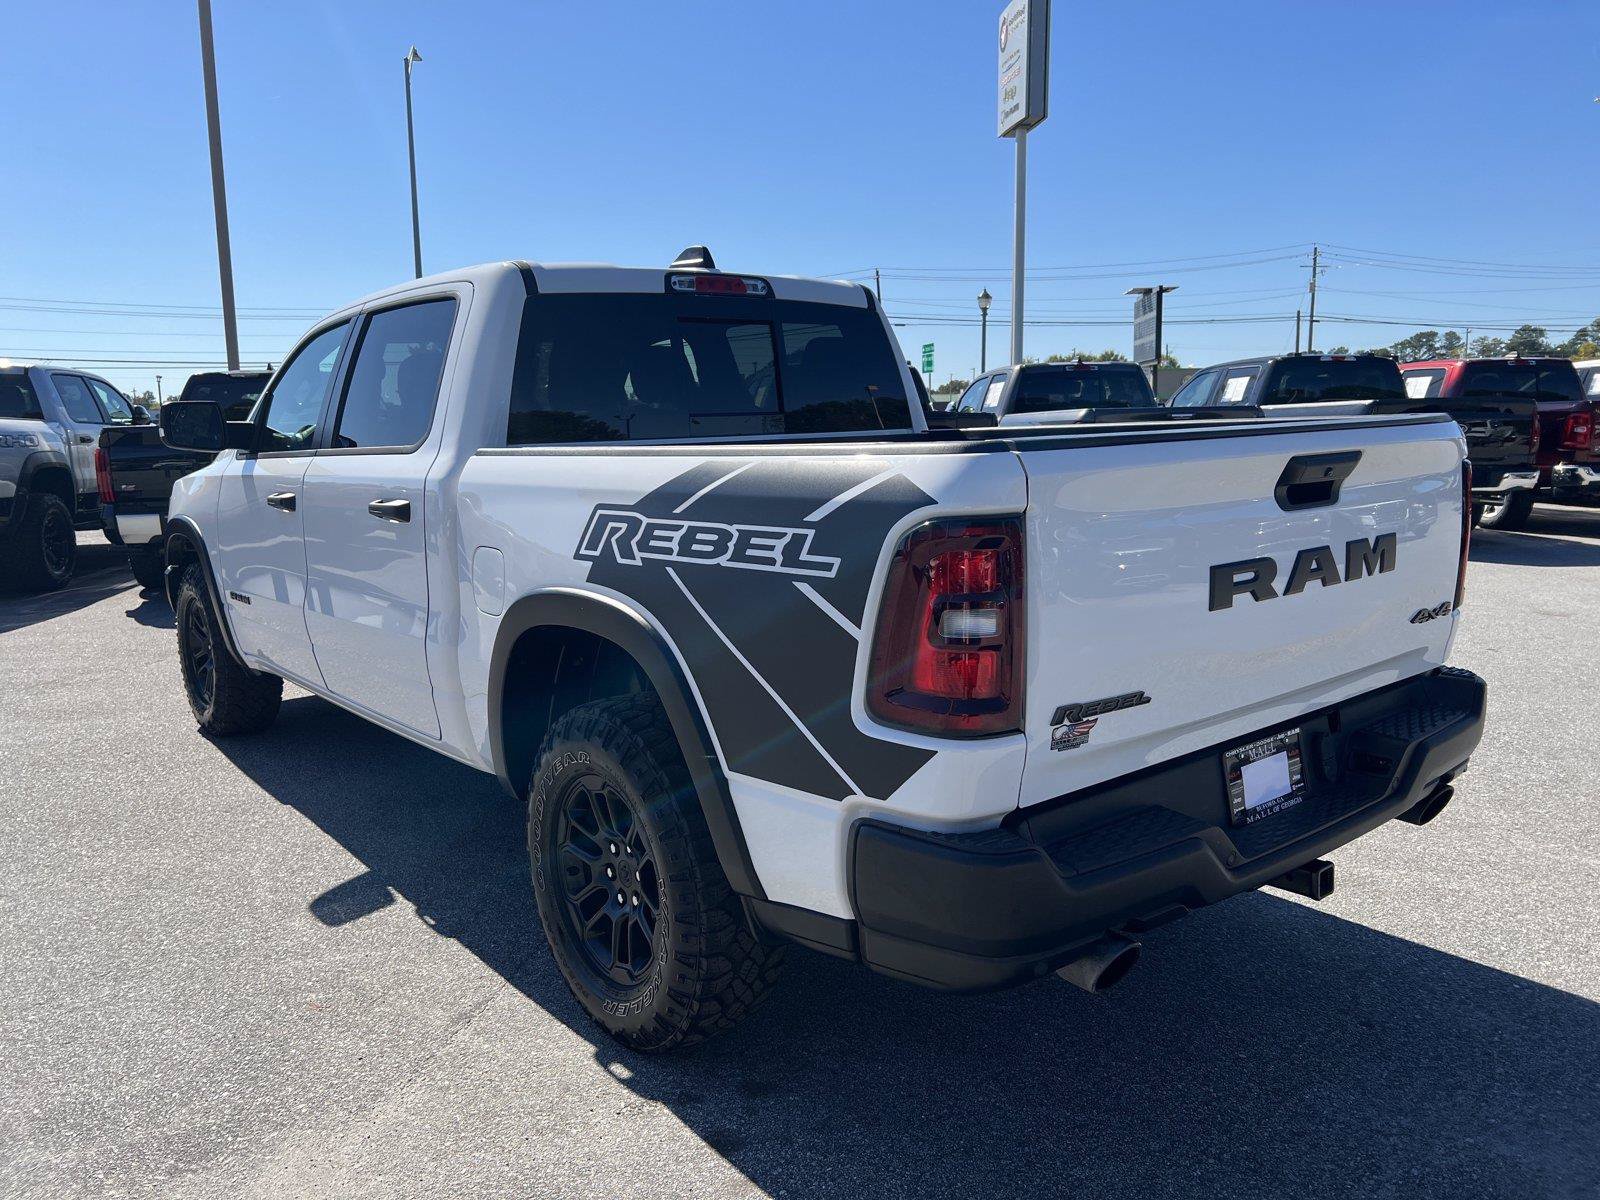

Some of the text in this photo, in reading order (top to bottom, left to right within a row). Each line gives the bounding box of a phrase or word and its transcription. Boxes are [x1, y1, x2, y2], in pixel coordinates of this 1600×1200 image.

[580, 509, 842, 578] REBEL
[1208, 532, 1398, 612] RAM
[1049, 690, 1152, 726] REBEL
[530, 751, 591, 892] GOODYEAR
[1246, 808, 1273, 824] MALL
